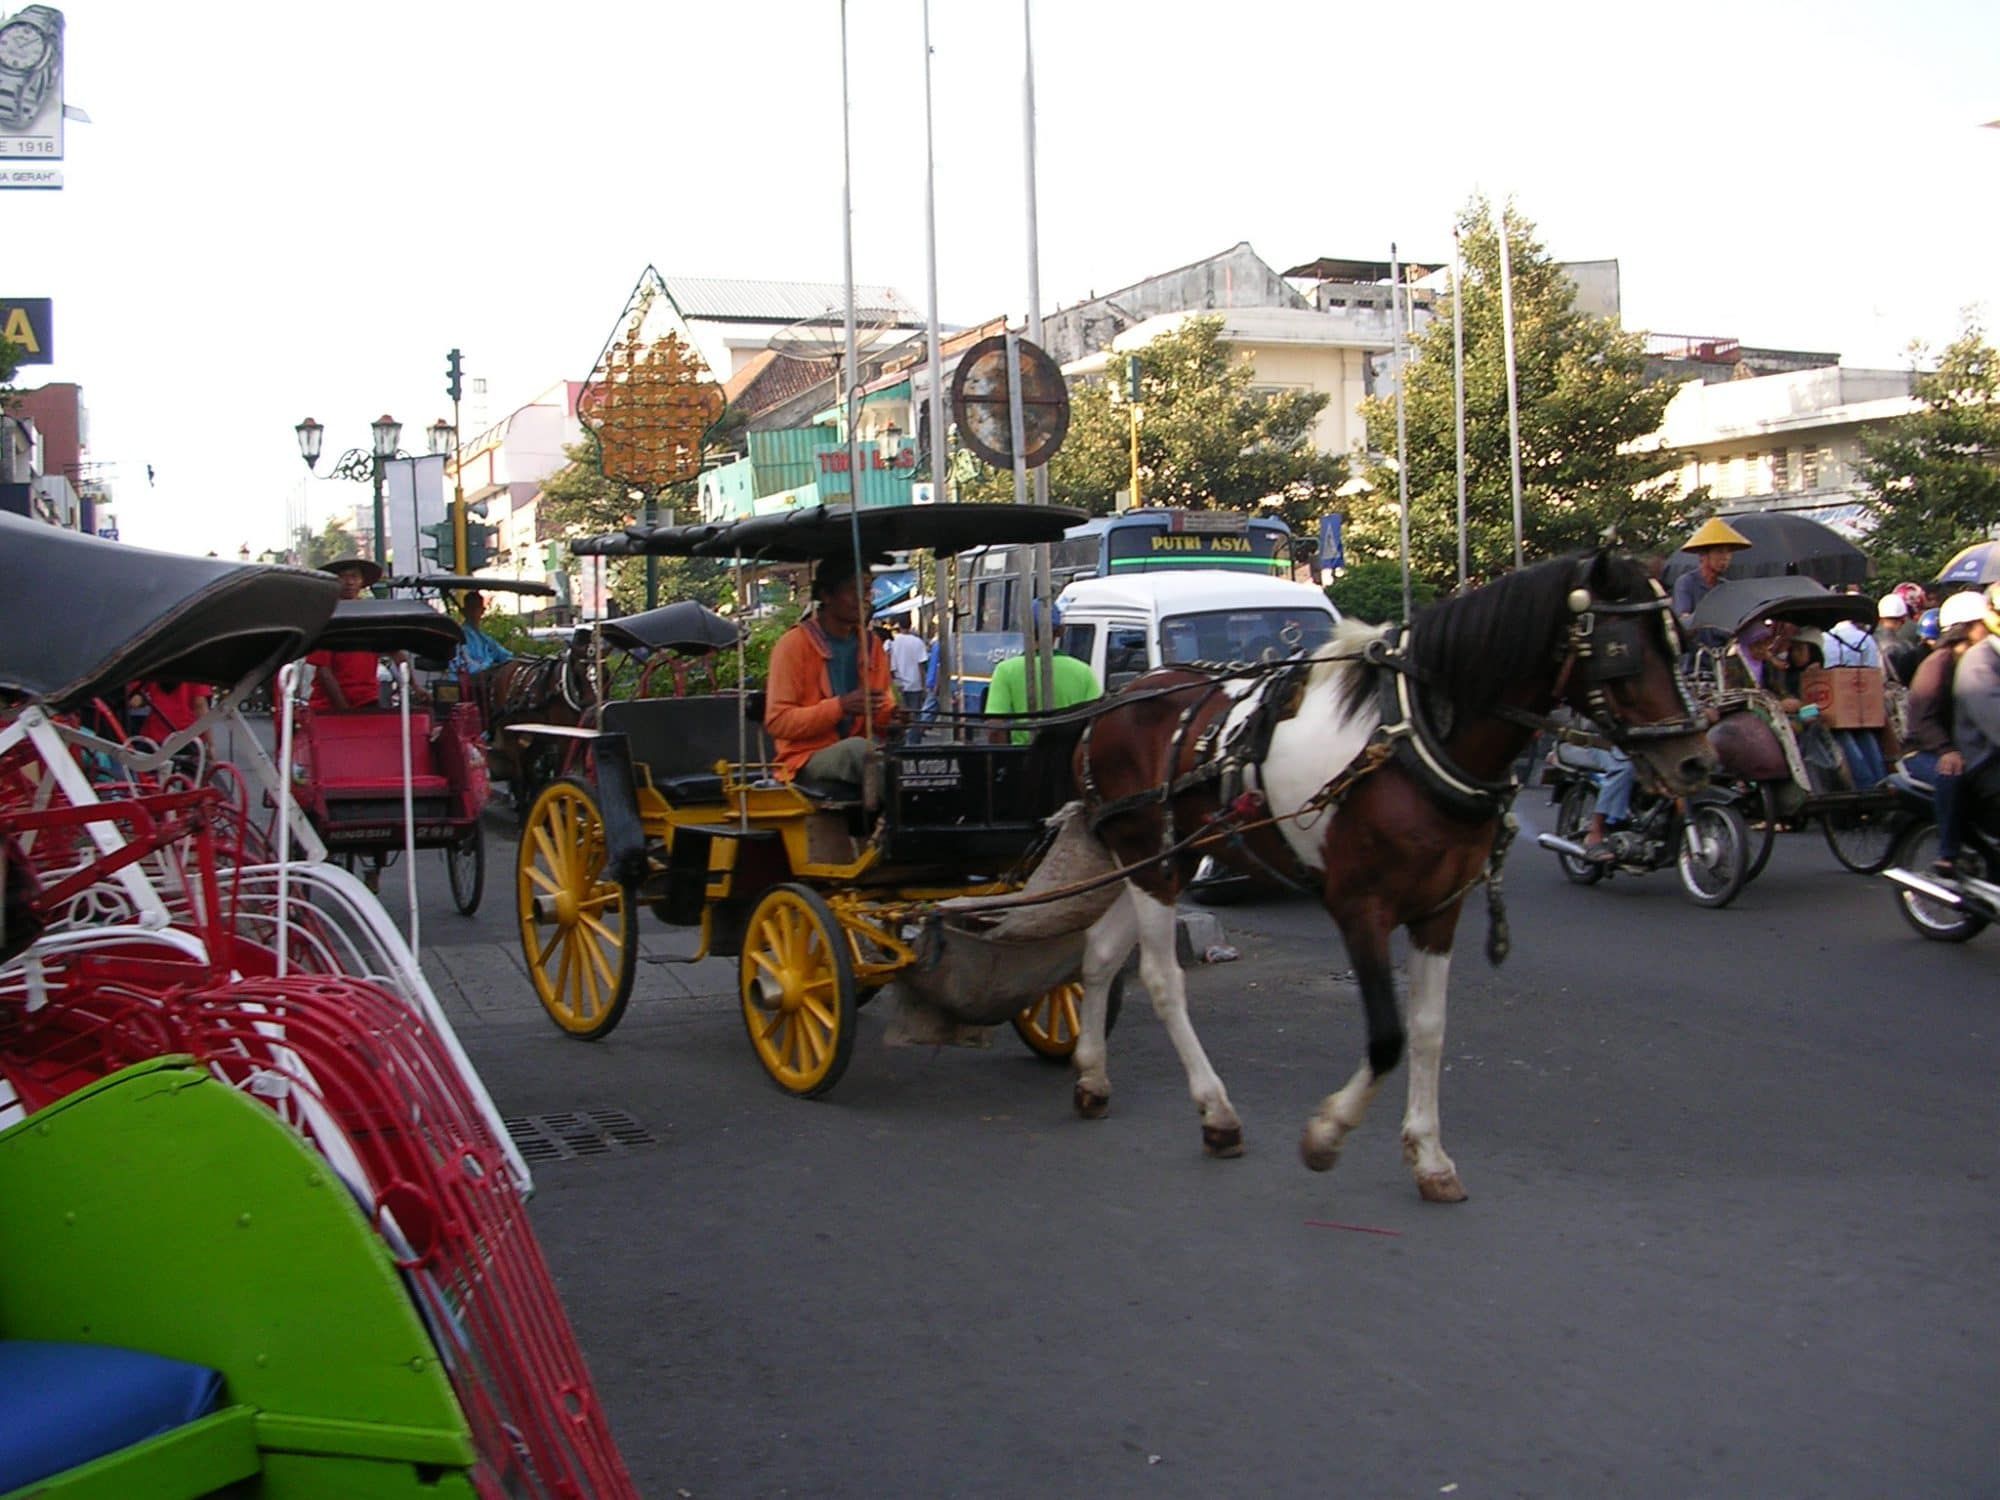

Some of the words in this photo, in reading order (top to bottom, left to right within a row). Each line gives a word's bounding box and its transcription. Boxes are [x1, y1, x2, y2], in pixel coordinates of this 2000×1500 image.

[18, 141, 54, 153] 1918
[4, 308, 40, 352] A
[1152, 536, 1201, 550] PUTRI
[1211, 538, 1252, 552] ASYA
